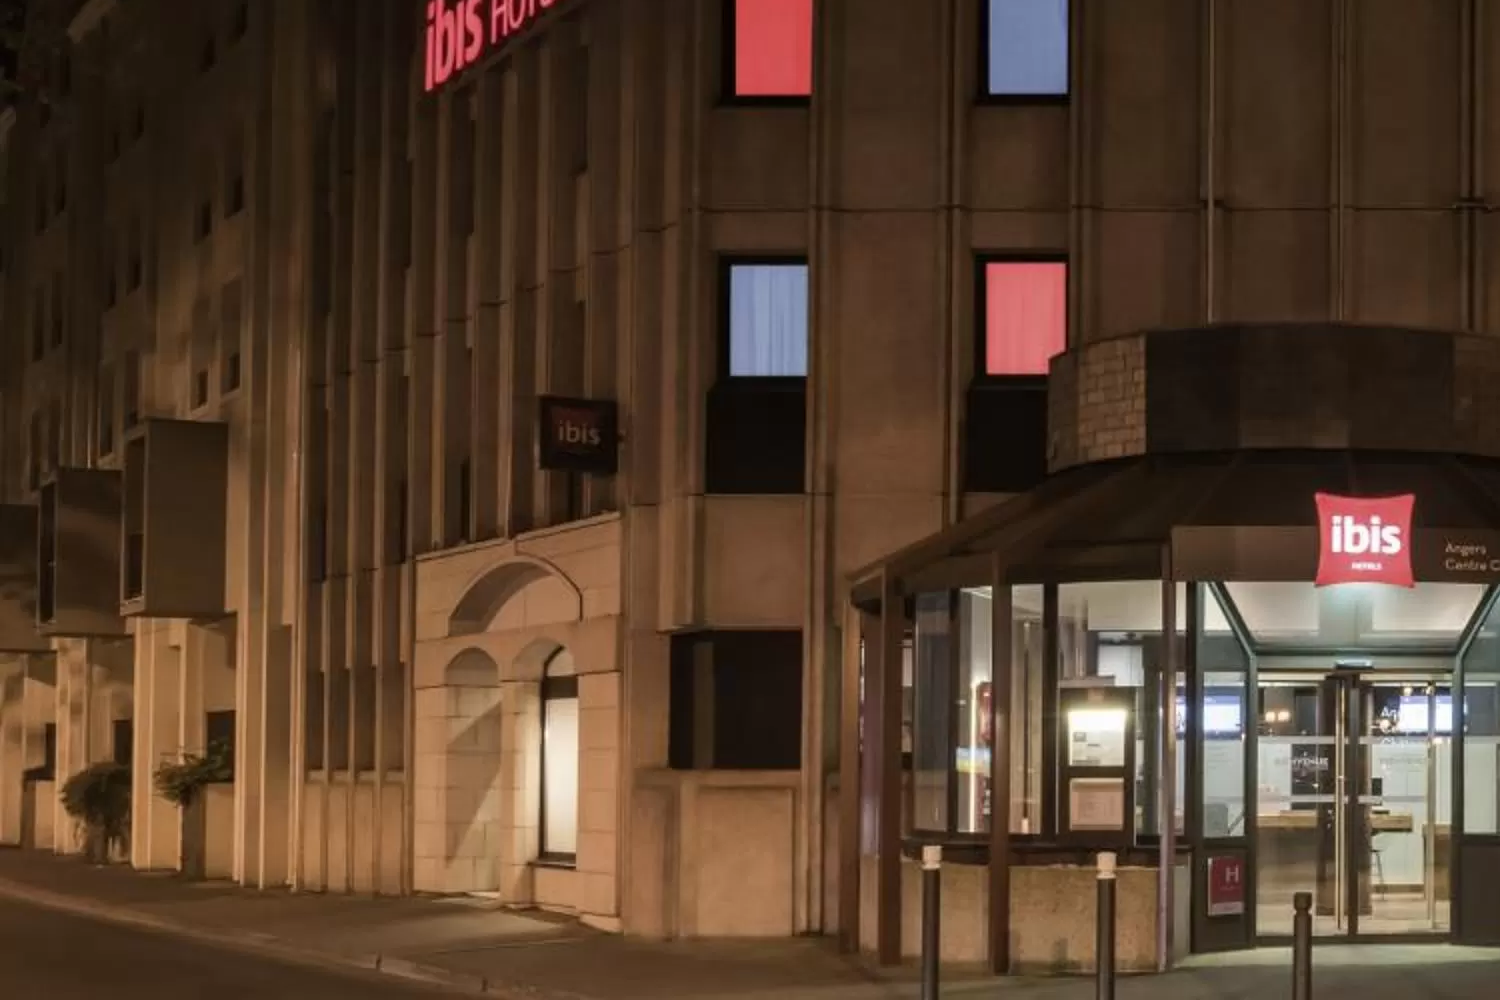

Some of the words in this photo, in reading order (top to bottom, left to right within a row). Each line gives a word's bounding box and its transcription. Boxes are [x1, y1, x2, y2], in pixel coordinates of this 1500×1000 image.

[558, 420, 602, 445] ibis
[1331, 515, 1402, 555] ibis
[1445, 543, 1486, 557] Angers
[1445, 558, 1487, 571] Centre
[1225, 865, 1239, 883] H
